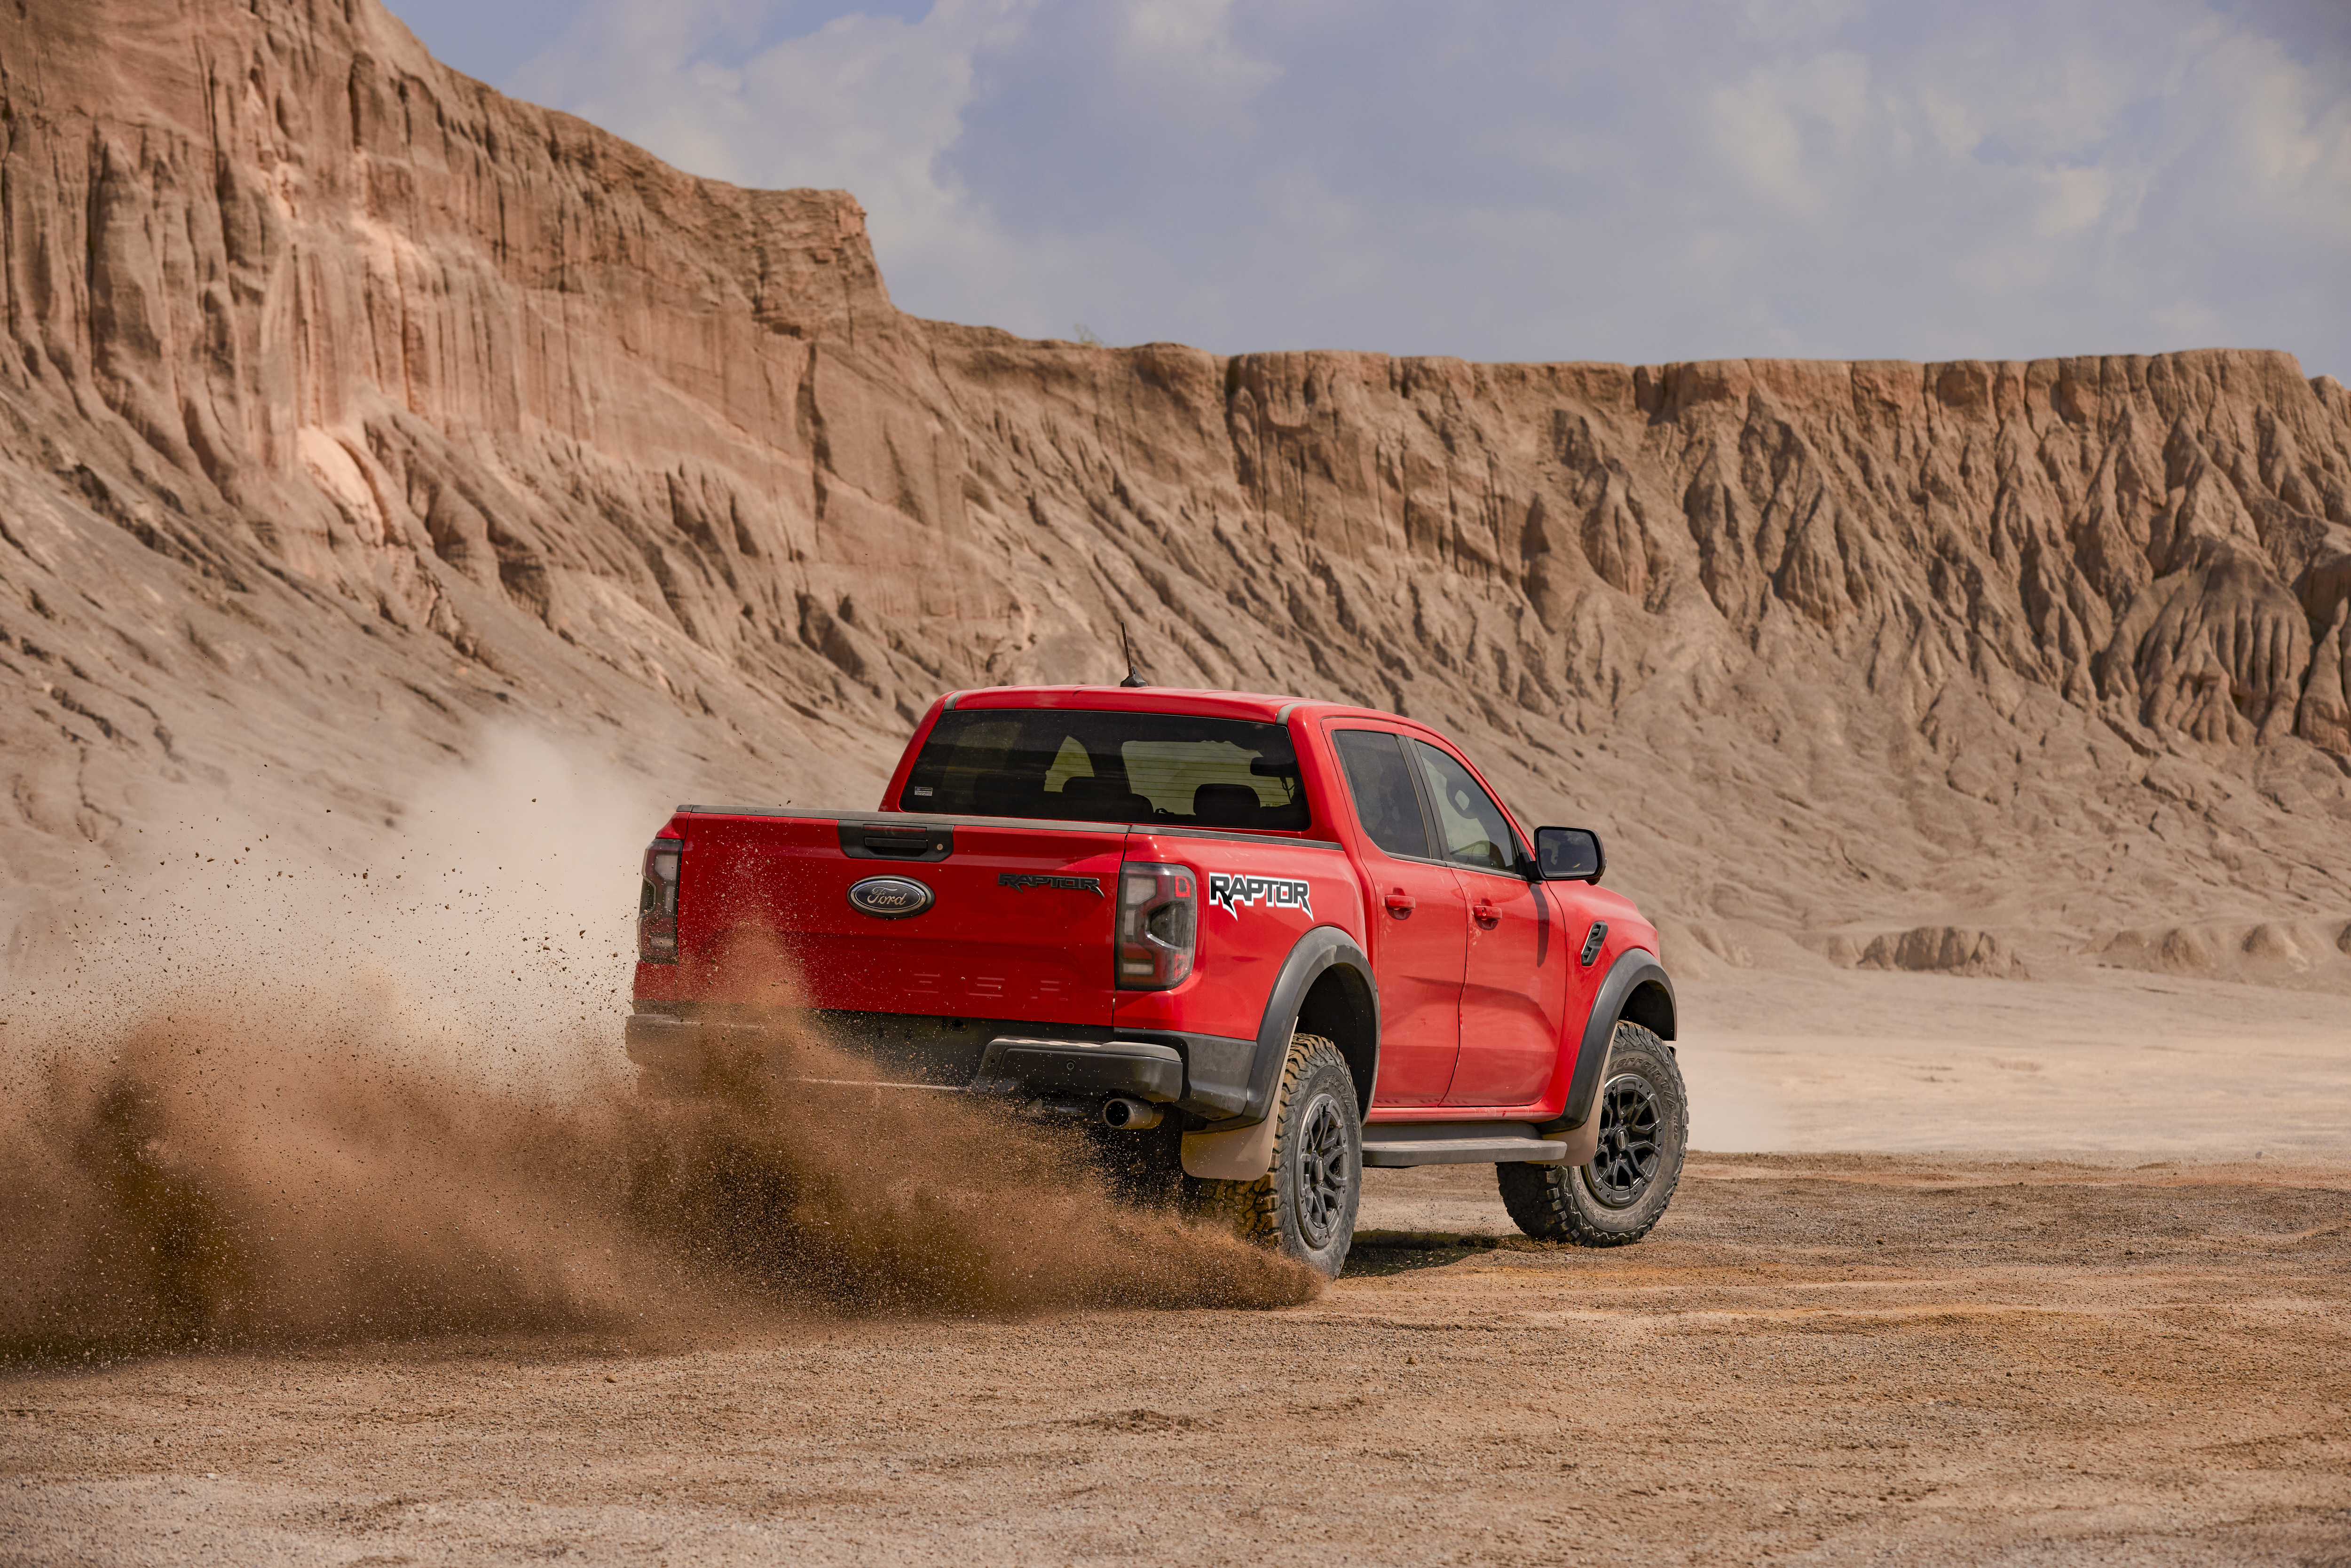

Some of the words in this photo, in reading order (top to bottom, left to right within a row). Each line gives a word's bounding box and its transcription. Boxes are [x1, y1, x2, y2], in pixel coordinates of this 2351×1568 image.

[867, 886, 907, 906] Ford
[998, 873, 1104, 898] RAPTOR
[1209, 872, 1314, 922] RAPTOR
[1609, 1057, 1663, 1080] Terrain
[1576, 1182, 1656, 1224] BFGoodrich
